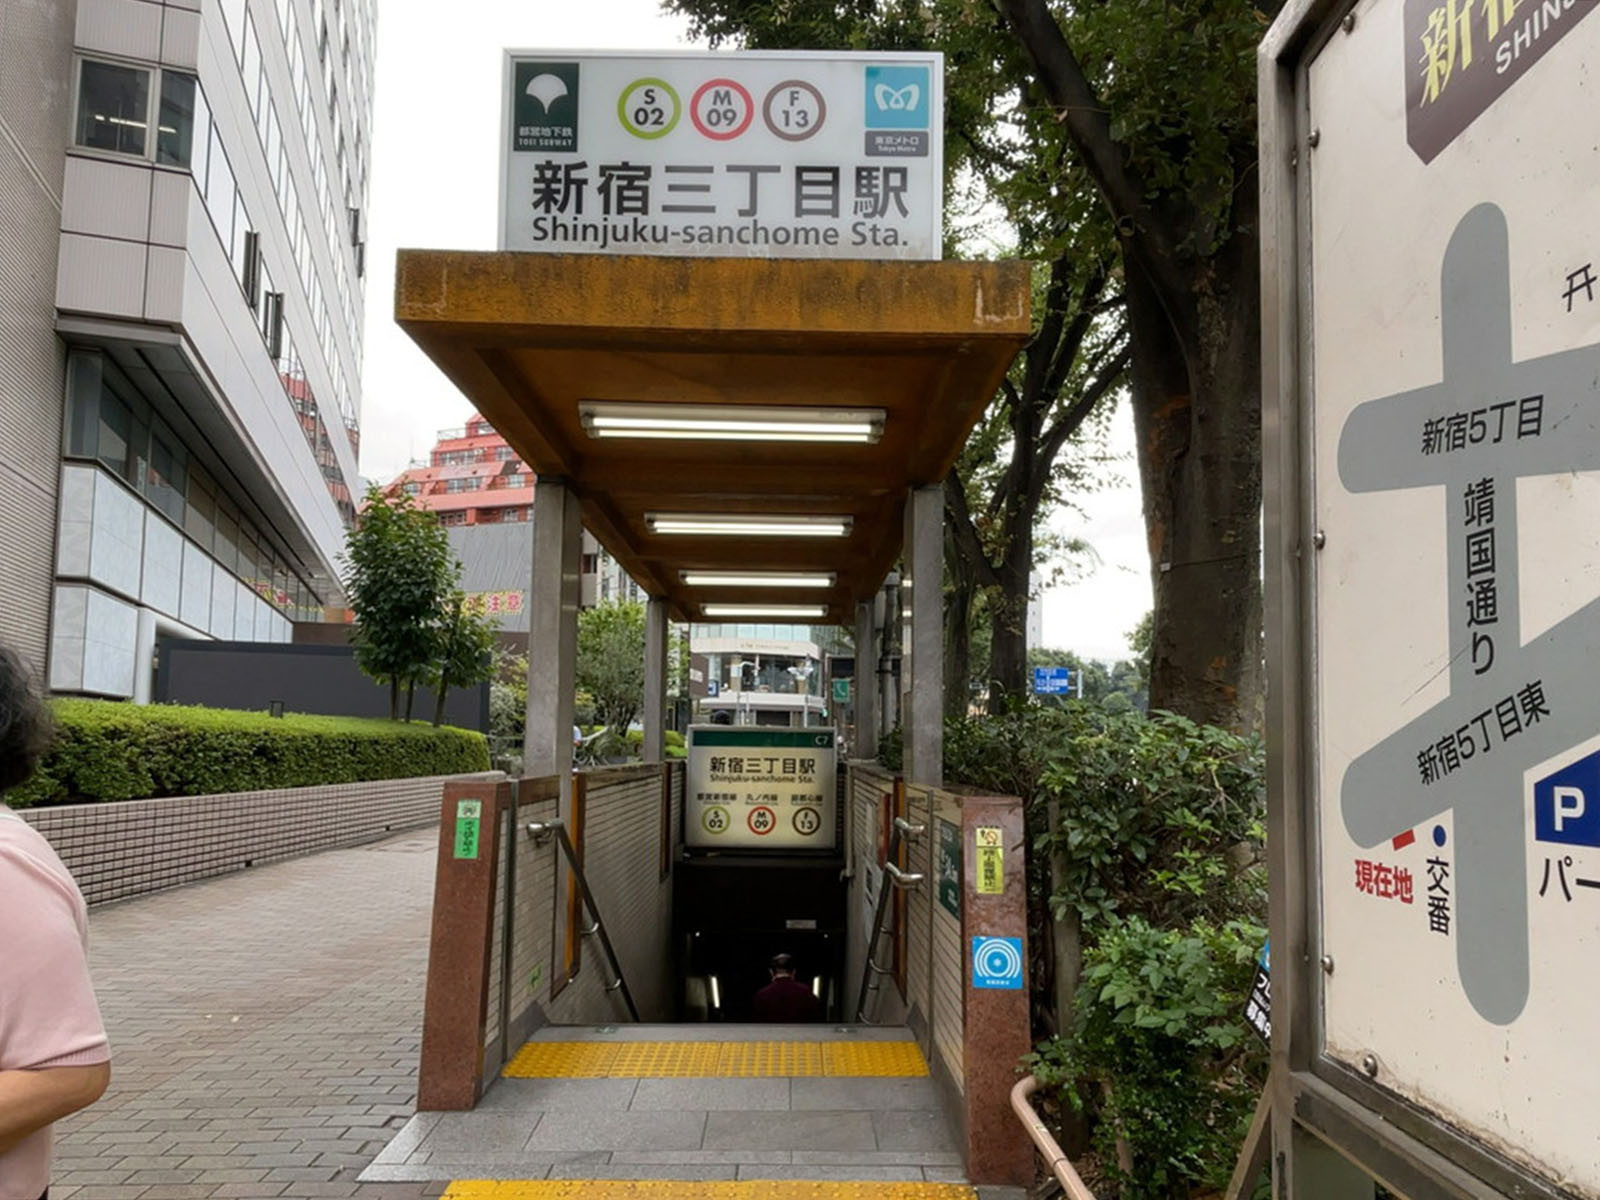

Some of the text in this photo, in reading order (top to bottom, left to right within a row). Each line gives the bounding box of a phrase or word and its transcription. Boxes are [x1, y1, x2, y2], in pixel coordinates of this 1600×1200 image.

[644, 88, 656, 105] S
[712, 90, 732, 106] M
[789, 91, 800, 106] F
[634, 107, 664, 126] 02
[707, 108, 737, 126] 09
[782, 109, 809, 128] 13
[874, 136, 919, 146] 東京メトロ
[532, 160, 909, 219] 新宿三丁目駅
[532, 216, 909, 248] Shinjuku-sanchome Sta.
[1421, 394, 1545, 456] 新宿5丁目
[1463, 477, 1499, 676] 靖国通り
[1416, 680, 1550, 786] 新宿5丁目東
[710, 756, 816, 774] 新宿三丁目駅
[710, 774, 814, 784] Shinjuku-sanchome Sta.
[713, 810, 720, 819] S
[756, 811, 767, 819] M
[1553, 786, 1585, 832] P
[708, 819, 723, 829] 02
[754, 819, 769, 829] 09
[800, 820, 814, 830] 13
[1354, 859, 1414, 904] 現在地
[1426, 856, 1450, 936] 交番
